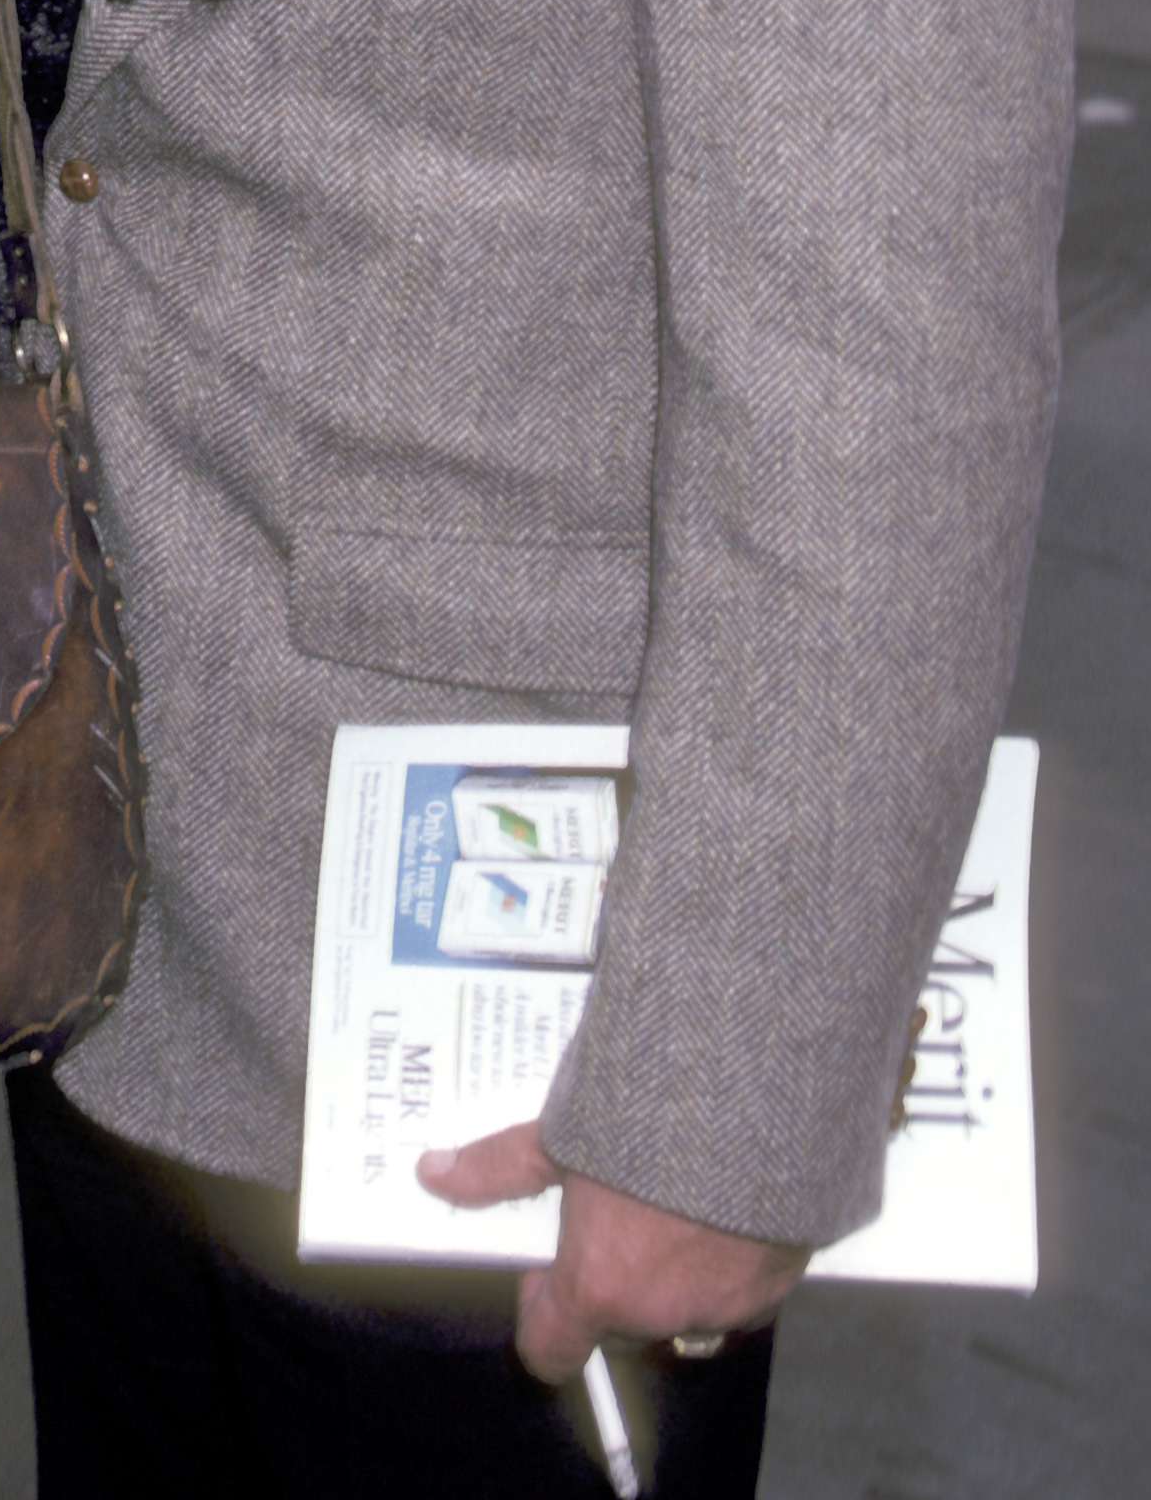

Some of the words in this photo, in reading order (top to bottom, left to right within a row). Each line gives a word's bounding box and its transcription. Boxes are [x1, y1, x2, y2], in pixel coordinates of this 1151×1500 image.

[418, 800, 447, 847] Only
[421, 848, 442, 863] 4
[414, 866, 437, 899] mg
[415, 900, 435, 930] tar
[904, 881, 997, 1138] Merit
[368, 1008, 401, 1081] Ultra
